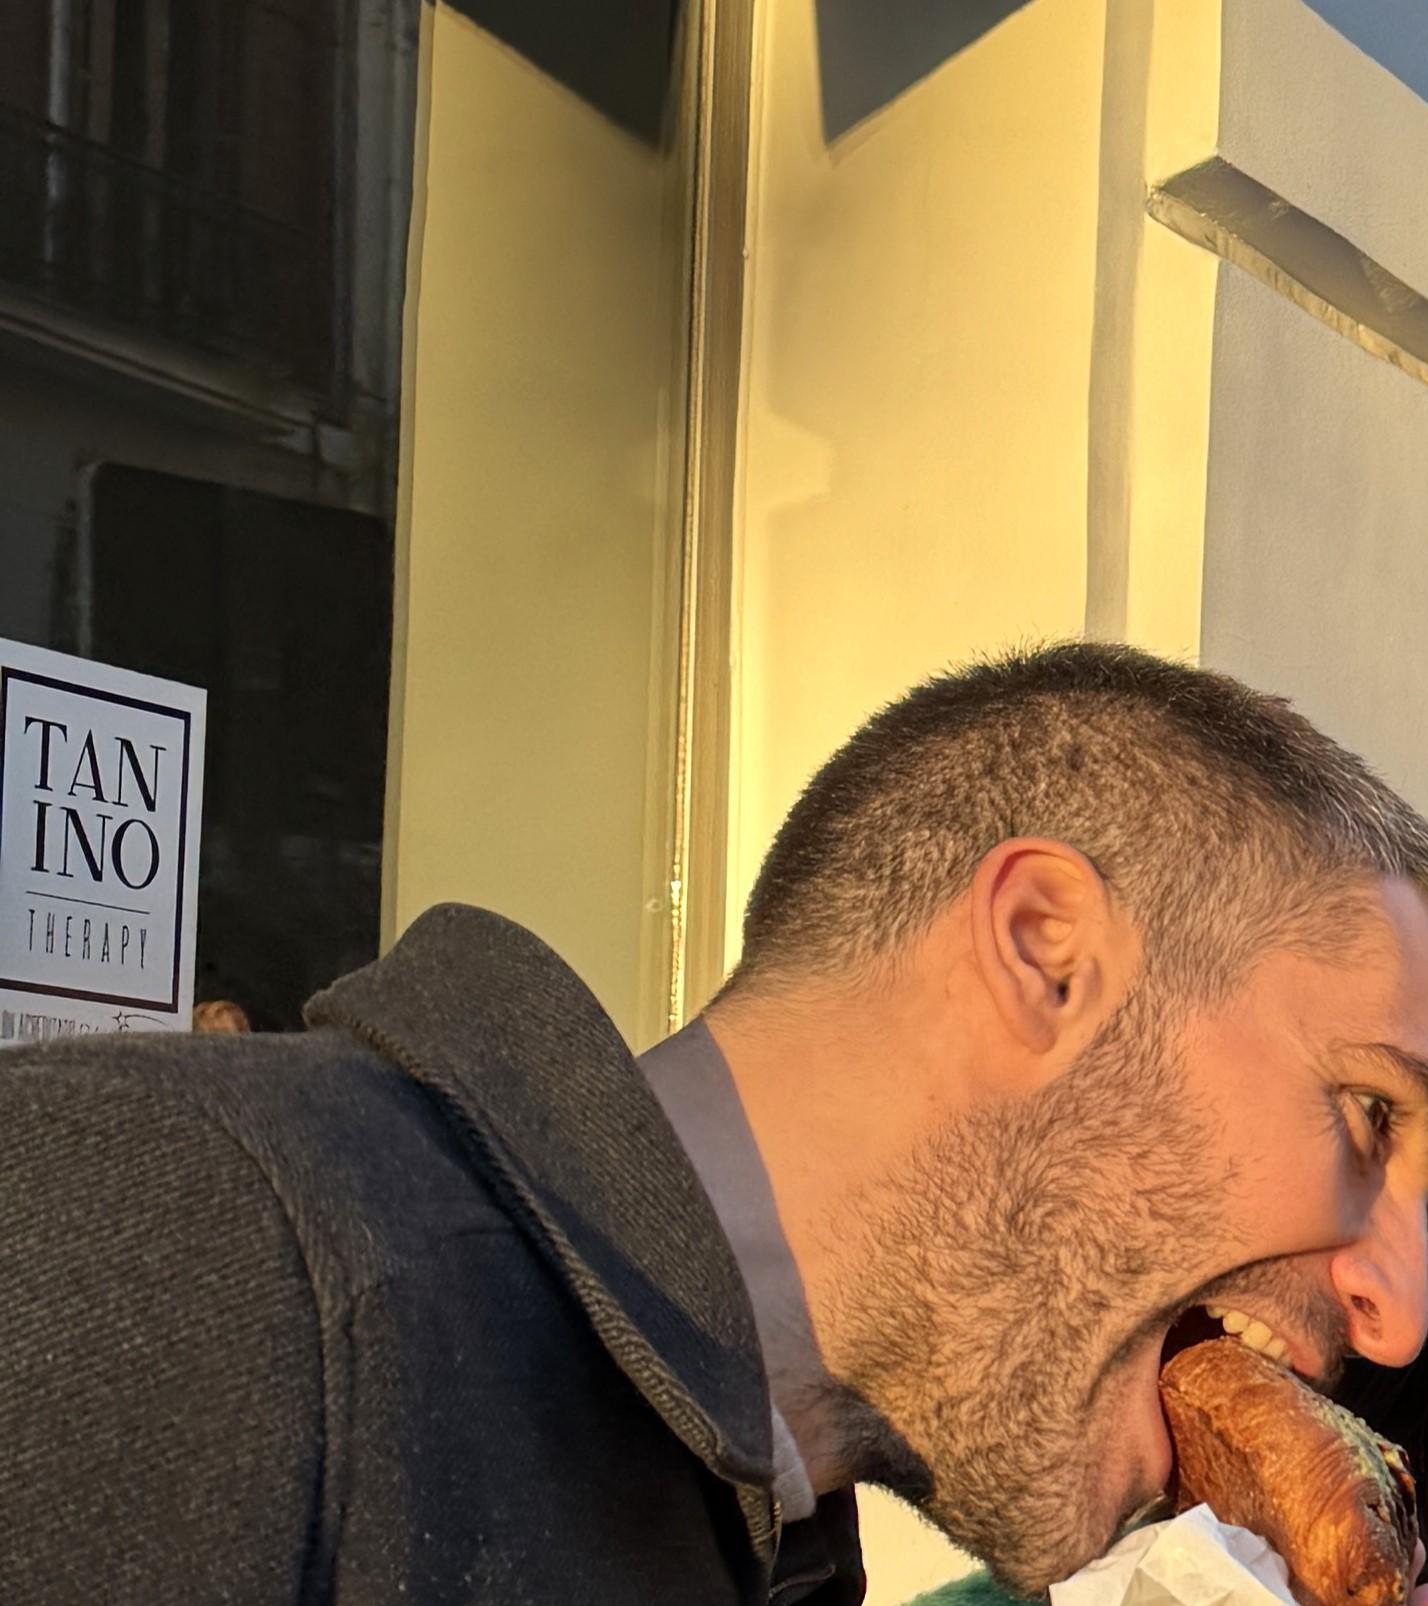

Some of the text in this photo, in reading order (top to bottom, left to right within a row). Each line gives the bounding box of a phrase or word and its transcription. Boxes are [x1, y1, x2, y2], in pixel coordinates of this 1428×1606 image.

[24, 716, 167, 813] TAN
[30, 800, 160, 890] INO
[28, 908, 149, 970] THERAPY
